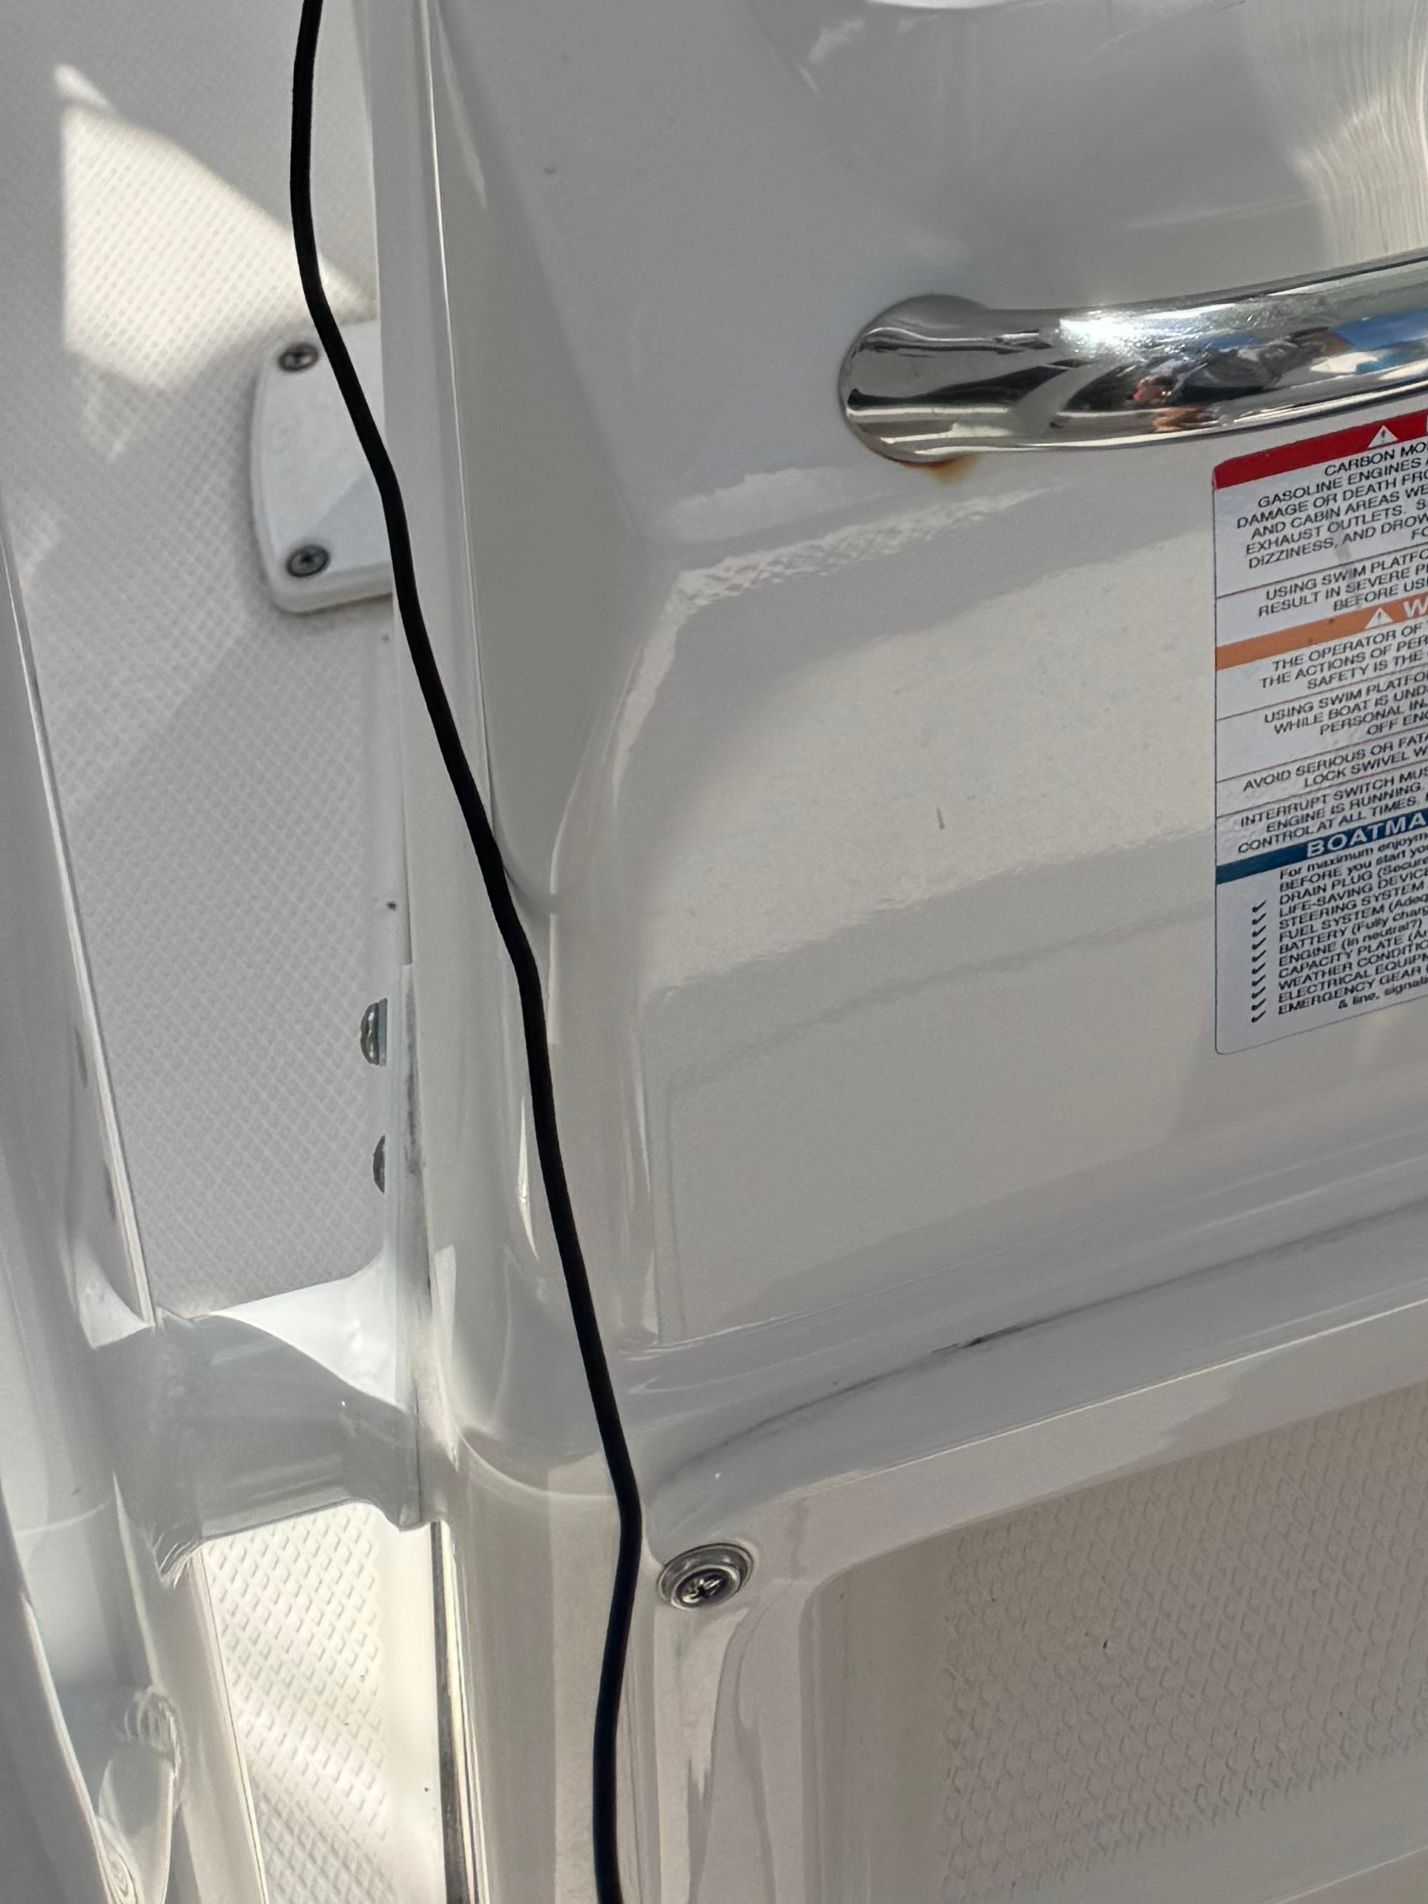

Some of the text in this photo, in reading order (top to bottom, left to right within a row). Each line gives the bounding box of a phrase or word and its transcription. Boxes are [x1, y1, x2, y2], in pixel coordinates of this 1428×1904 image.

[1323, 448, 1395, 477] CARBON
[1257, 476, 1342, 509] GASOLINE
[1347, 456, 1421, 485] ENGINES
[1236, 499, 1308, 529] DAMAGE
[1312, 492, 1337, 509] OR
[1342, 476, 1397, 501] DEATH
[1251, 519, 1286, 539] AND
[1289, 505, 1340, 529] CABIN
[1344, 490, 1400, 515] AREAS
[1246, 525, 1322, 555] EXHAUST
[1341, 525, 1376, 544] AND
